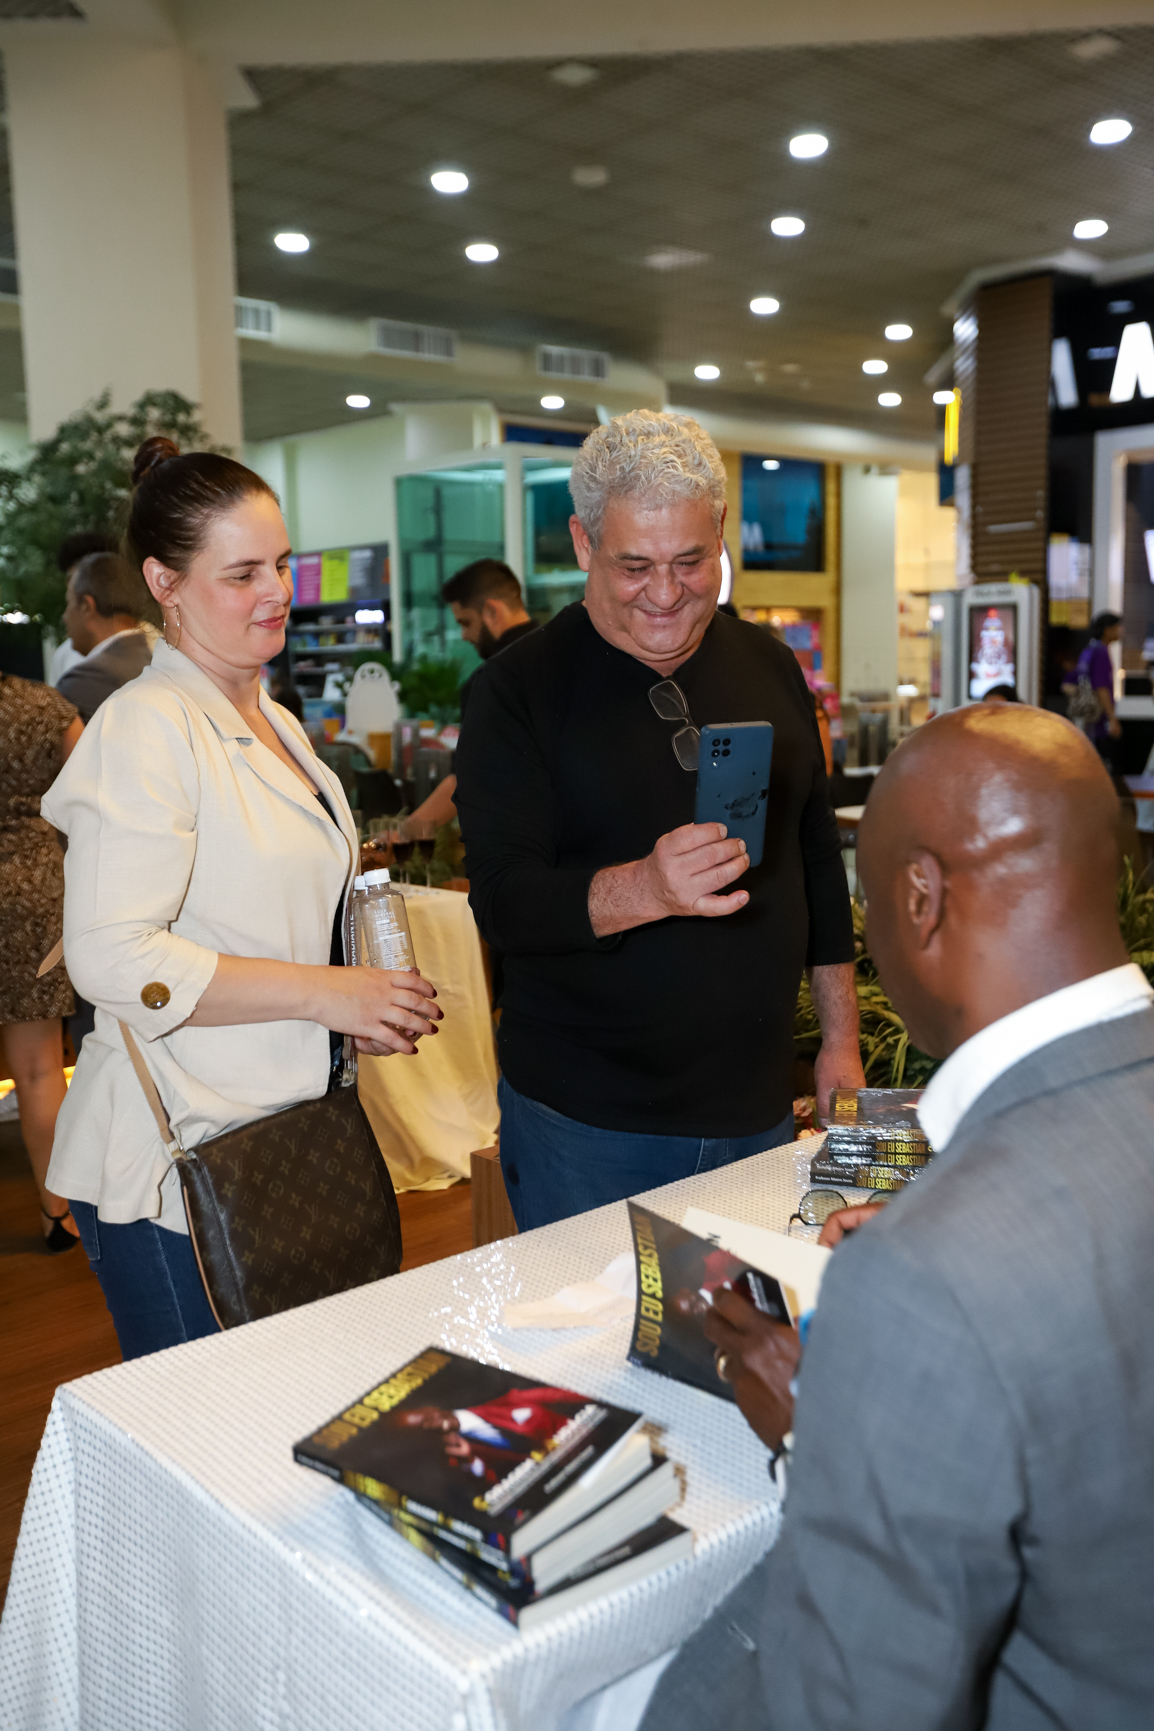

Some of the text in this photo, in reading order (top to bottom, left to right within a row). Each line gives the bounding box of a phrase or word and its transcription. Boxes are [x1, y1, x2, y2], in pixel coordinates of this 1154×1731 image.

[888, 1142, 895, 1153] EU
[888, 1154, 895, 1165] EU
[868, 1178, 875, 1188] EU
[641, 1294, 663, 1322] EU
